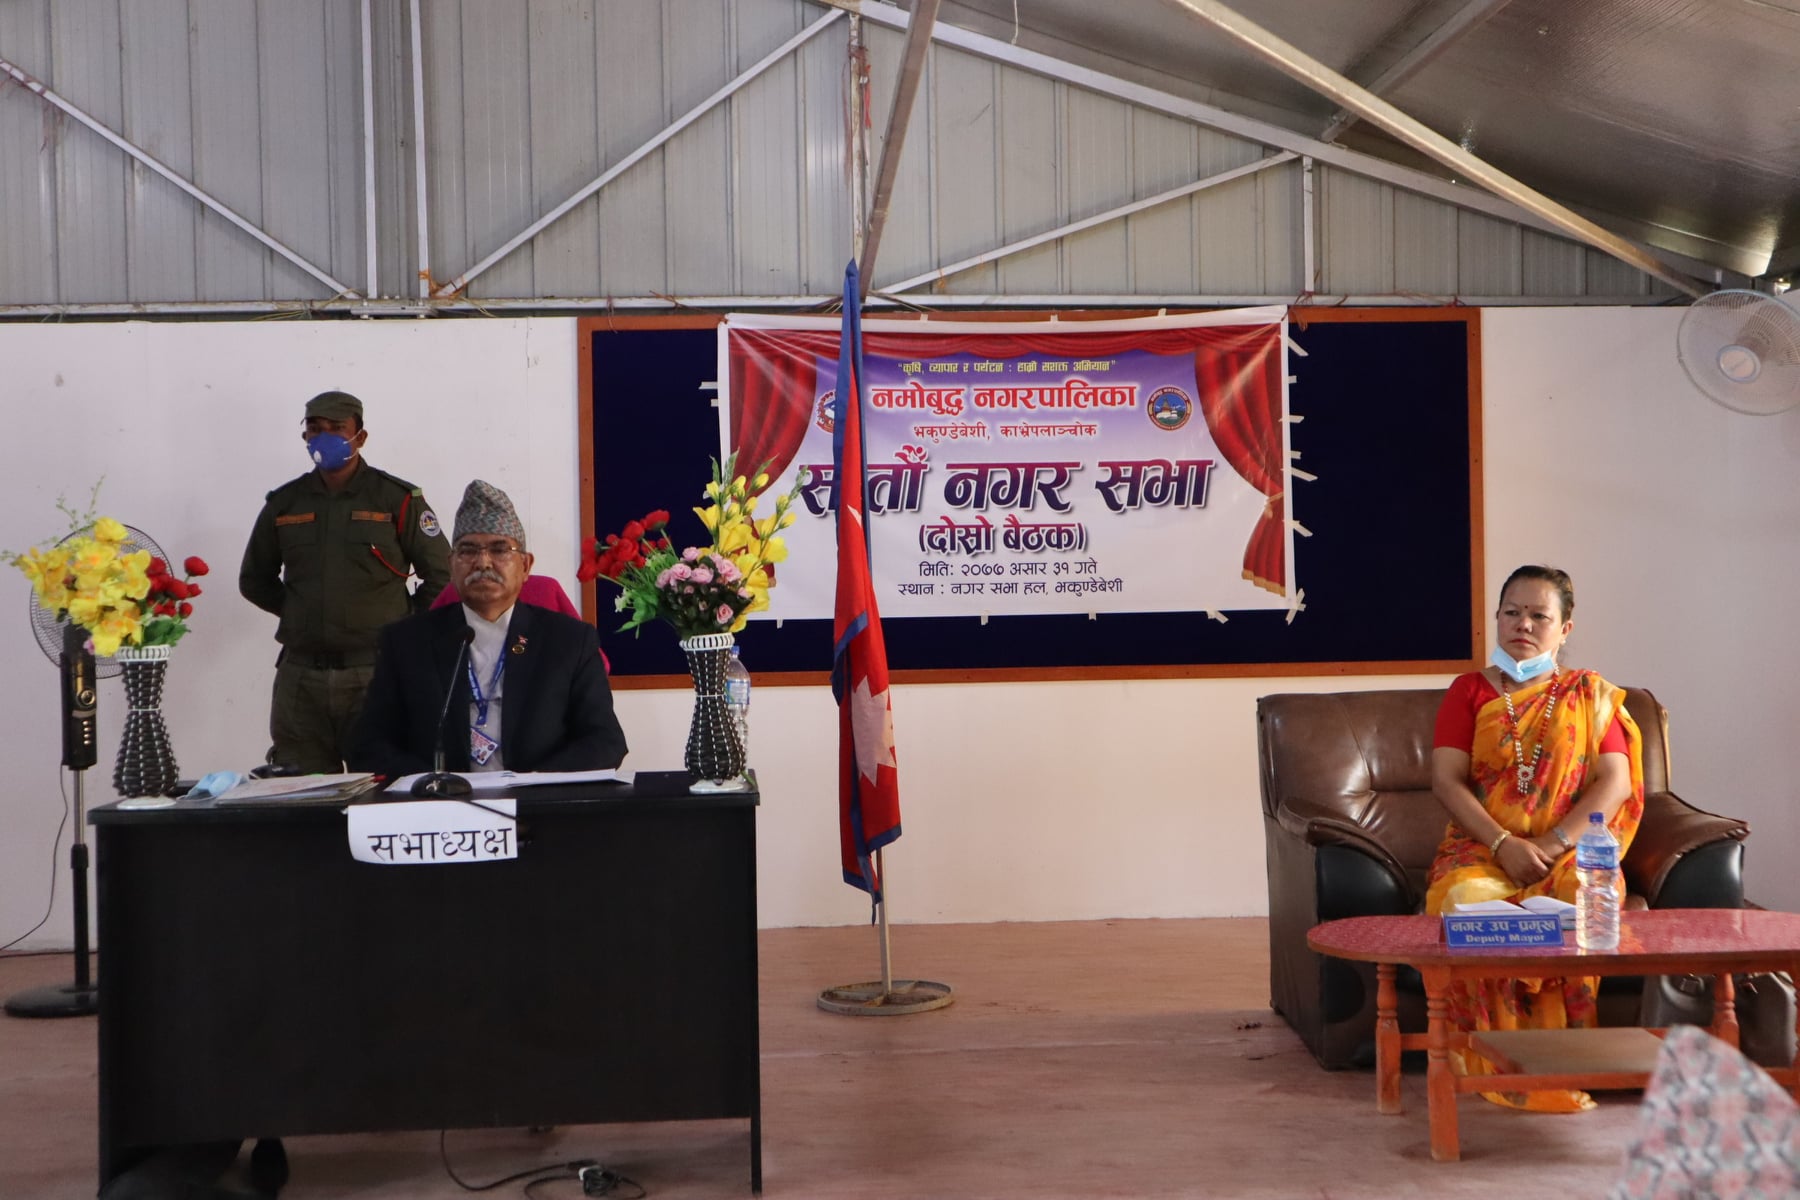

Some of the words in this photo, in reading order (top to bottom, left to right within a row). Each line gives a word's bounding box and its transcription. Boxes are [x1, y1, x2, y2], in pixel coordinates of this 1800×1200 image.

[929, 362, 959, 373] व्यापार
[963, 362, 970, 373] र
[973, 360, 1005, 373] पर्यटन
[1017, 361, 1038, 373] हाम्रो
[871, 381, 966, 416] नमोबुद्ध
[973, 379, 1137, 410] नगरपालिका
[913, 421, 991, 444] भकुण्डेबेशी,
[943, 461, 1085, 511] नगर
[1096, 458, 1214, 511] सभा
[919, 515, 994, 555] (दोस्रो
[1003, 513, 1085, 551] बैठक)
[918, 560, 954, 577] मिति:
[961, 563, 1005, 577] २०७७
[1009, 562, 1048, 576] असार
[1053, 561, 1069, 576] ३१
[1074, 557, 1098, 575] गते
[897, 583, 935, 596] स्थान
[950, 582, 985, 595] नगर
[990, 582, 1019, 594] सभा
[1023, 582, 1048, 596] हल,
[1054, 576, 1124, 597] भकुण्डेबेशी
[367, 827, 513, 861] सभाध्यक्ष
[1450, 921, 1486, 933] नगर
[1465, 934, 1506, 944] Deputy
[1509, 933, 1545, 944] Mayor
